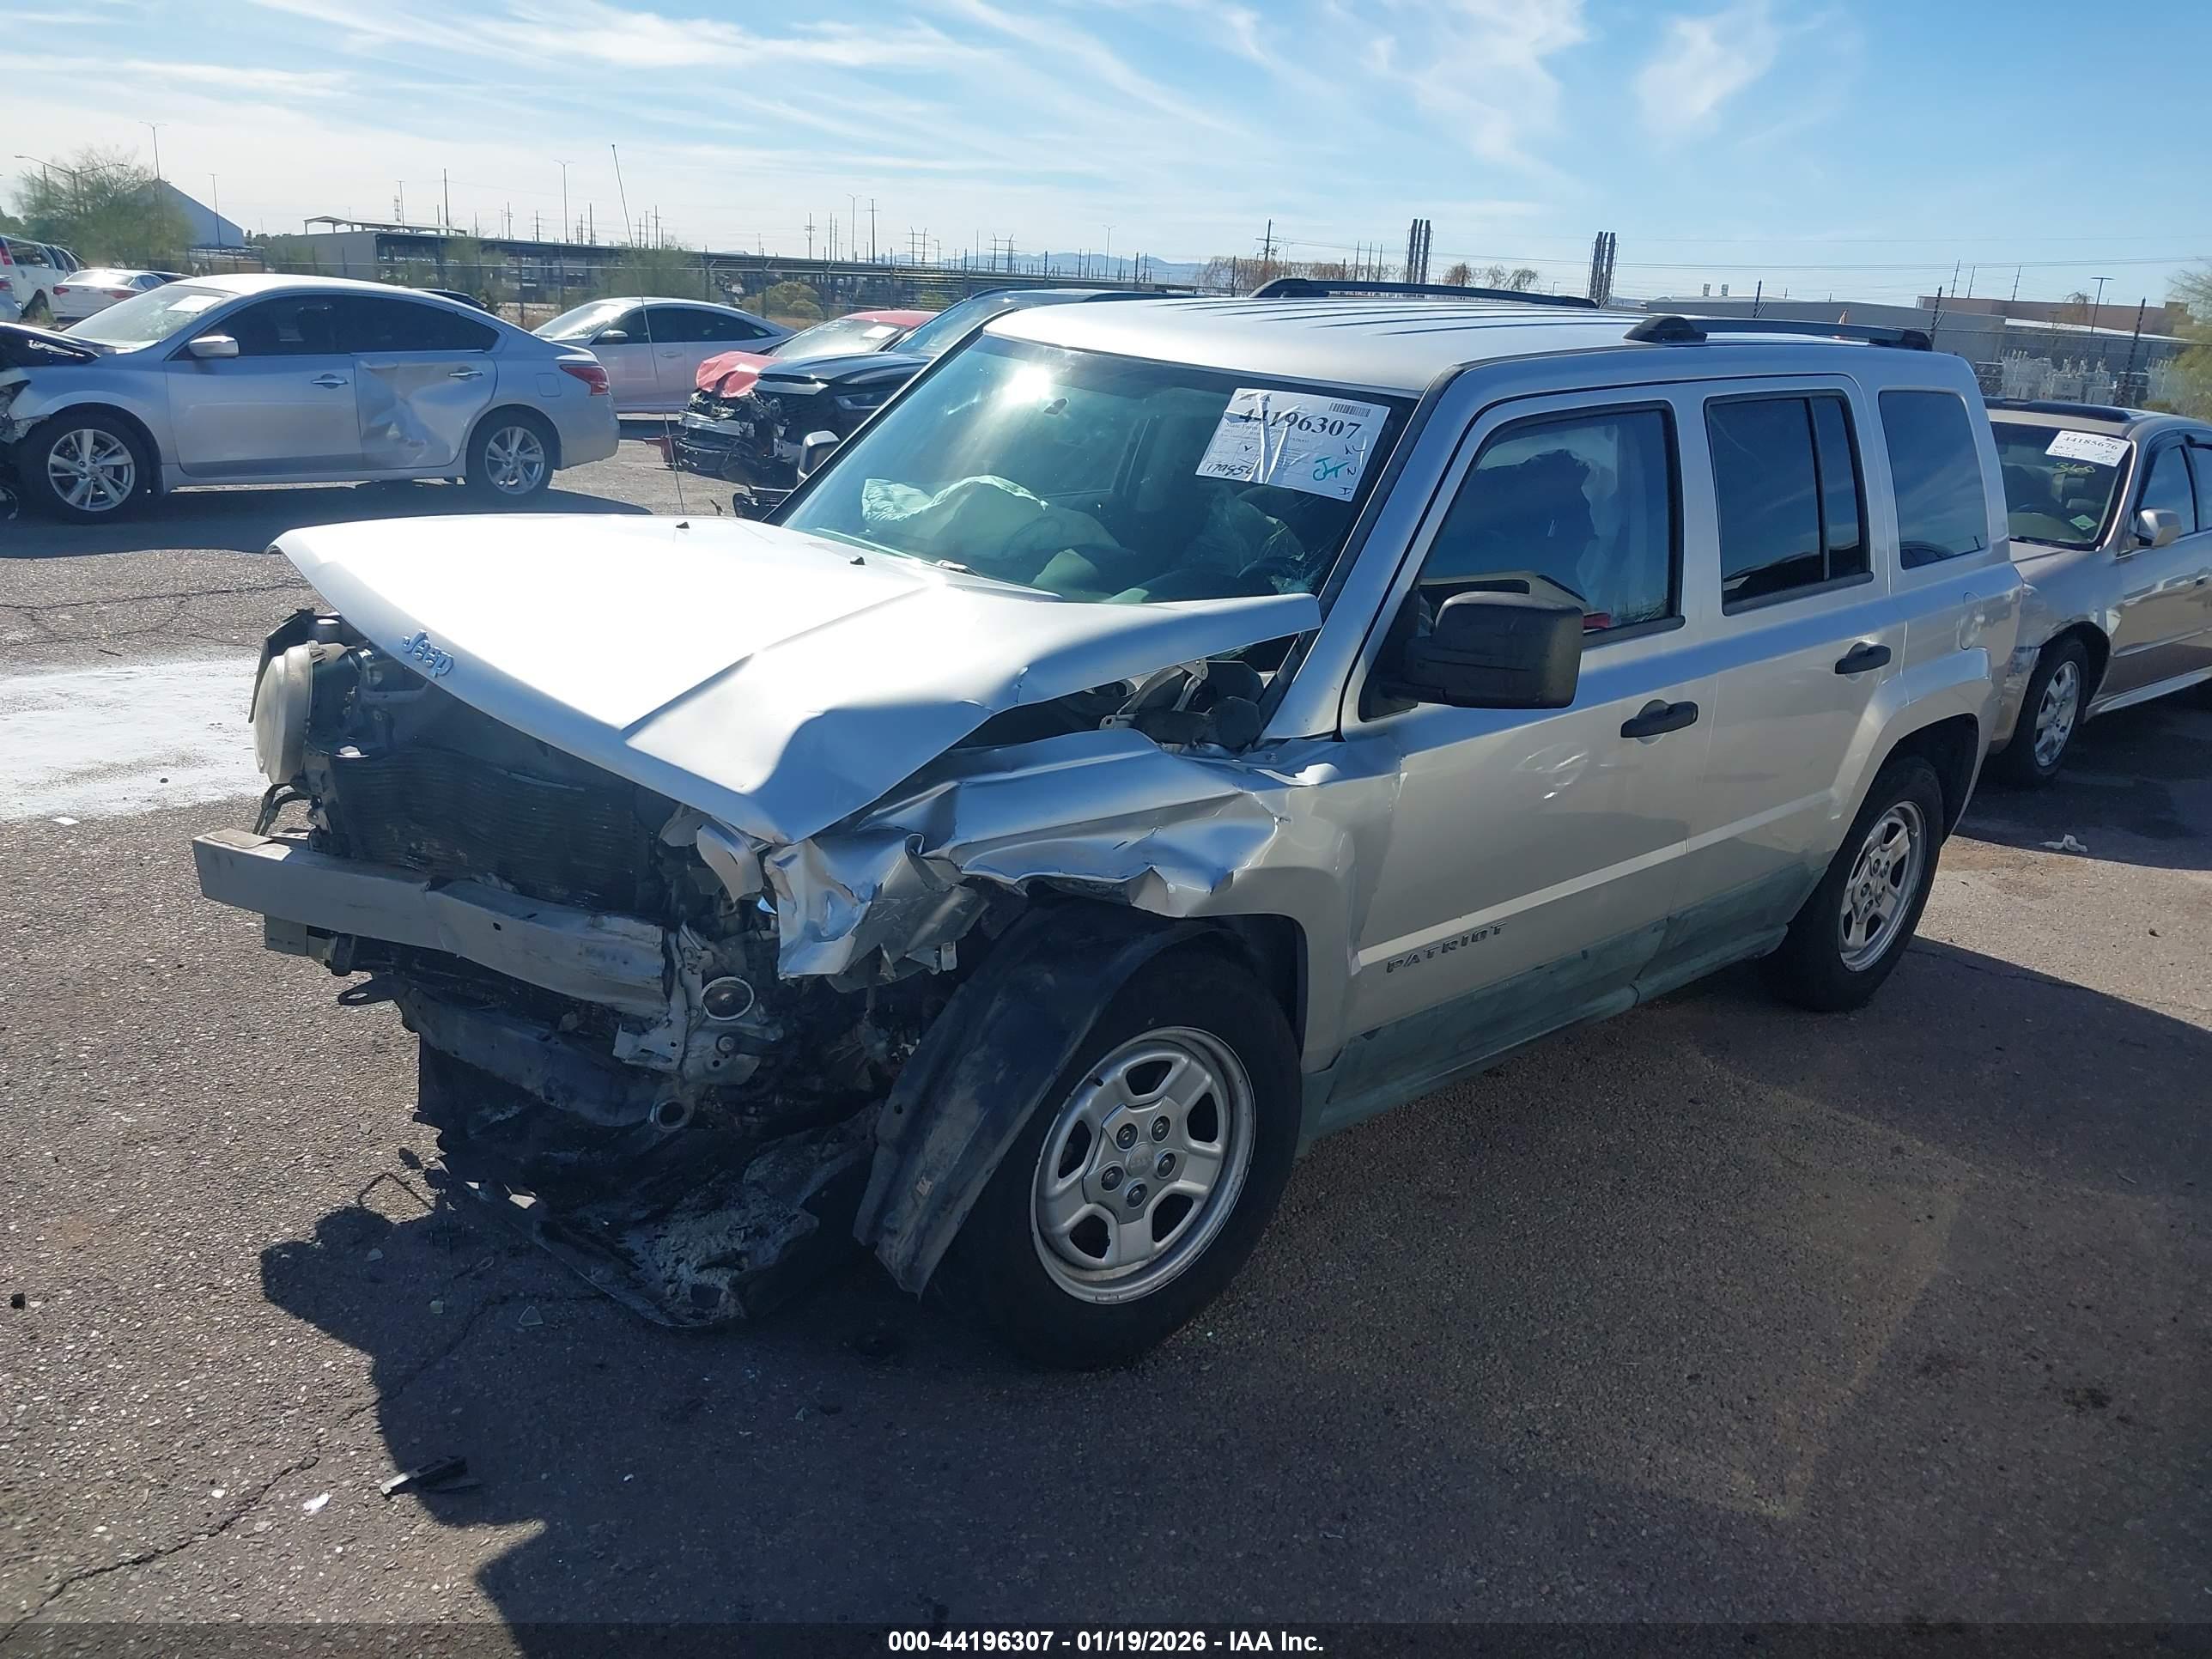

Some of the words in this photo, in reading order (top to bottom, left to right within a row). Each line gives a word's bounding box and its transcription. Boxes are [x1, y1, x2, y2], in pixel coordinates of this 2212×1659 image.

[1238, 407, 1363, 439] 44196307
[402, 628, 454, 678] Jeep
[1386, 921, 1508, 974] PATRIOT
